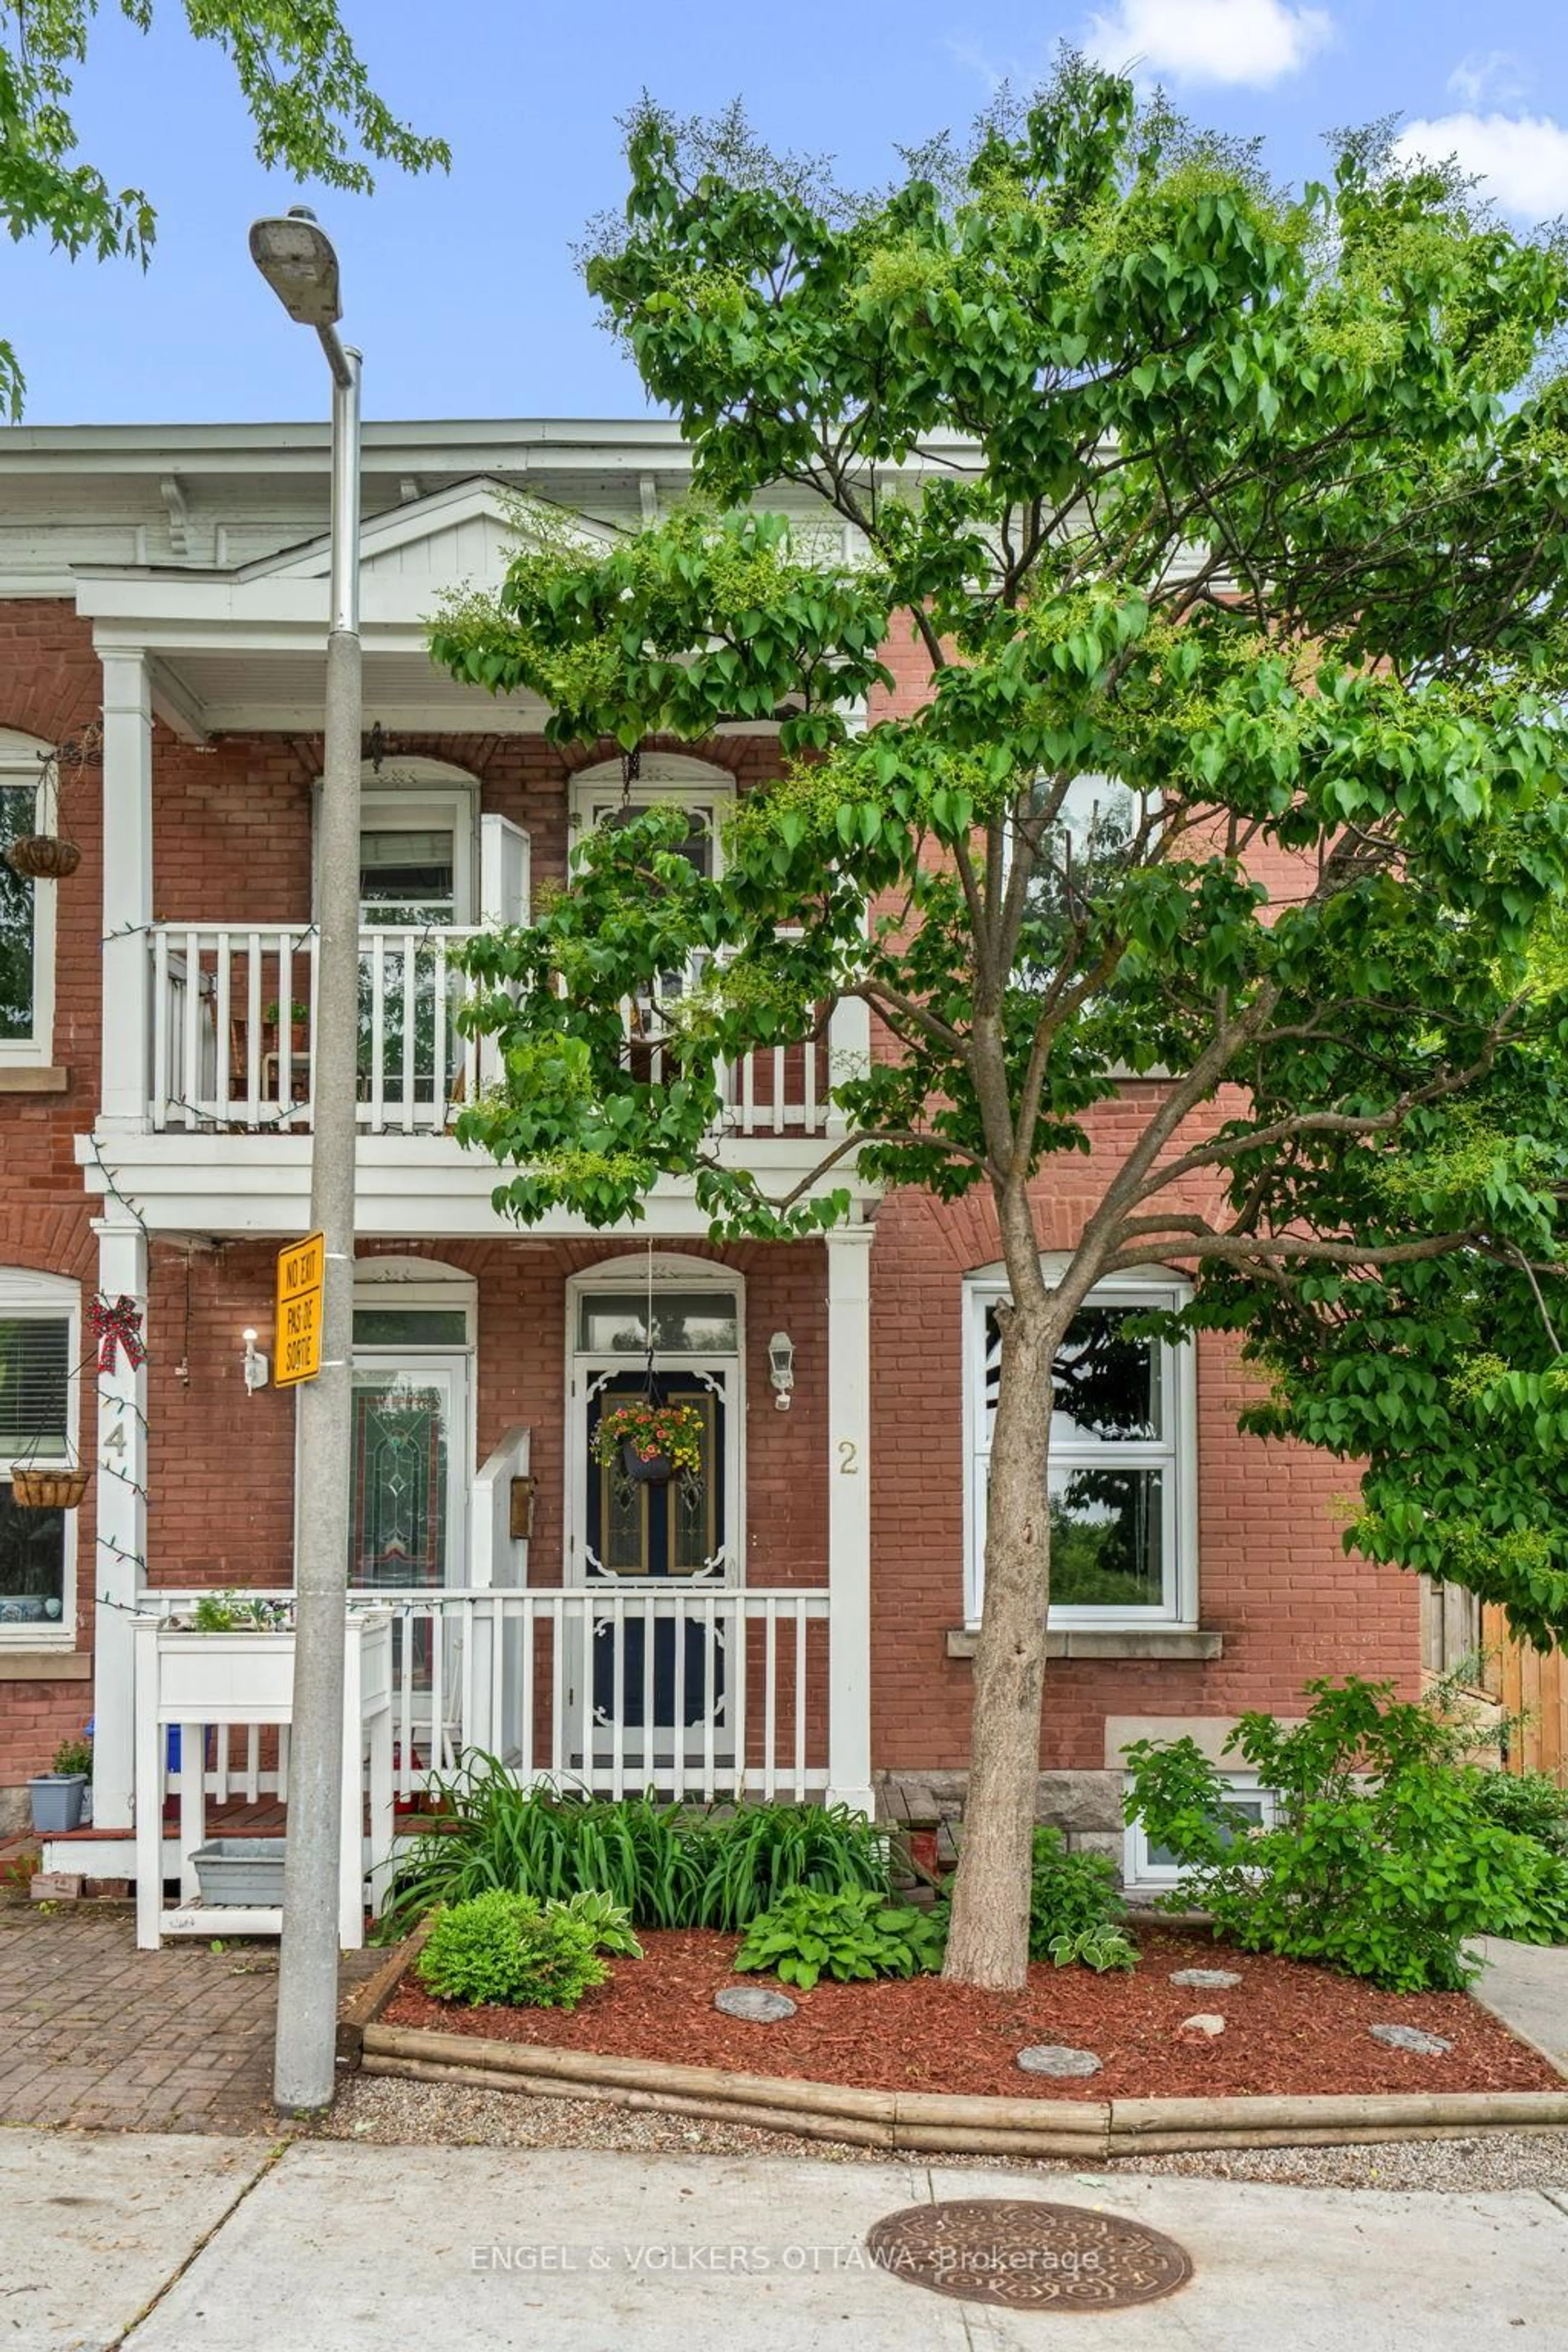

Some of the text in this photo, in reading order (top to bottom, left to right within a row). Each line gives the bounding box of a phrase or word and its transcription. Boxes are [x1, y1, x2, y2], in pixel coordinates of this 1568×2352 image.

[287, 1250, 316, 1290] NO EXIT
[287, 1299, 313, 1335] PAS DE
[287, 1336, 312, 1371] SORTIE
[104, 1423, 126, 1457] 4
[838, 1441, 858, 1474] 2
